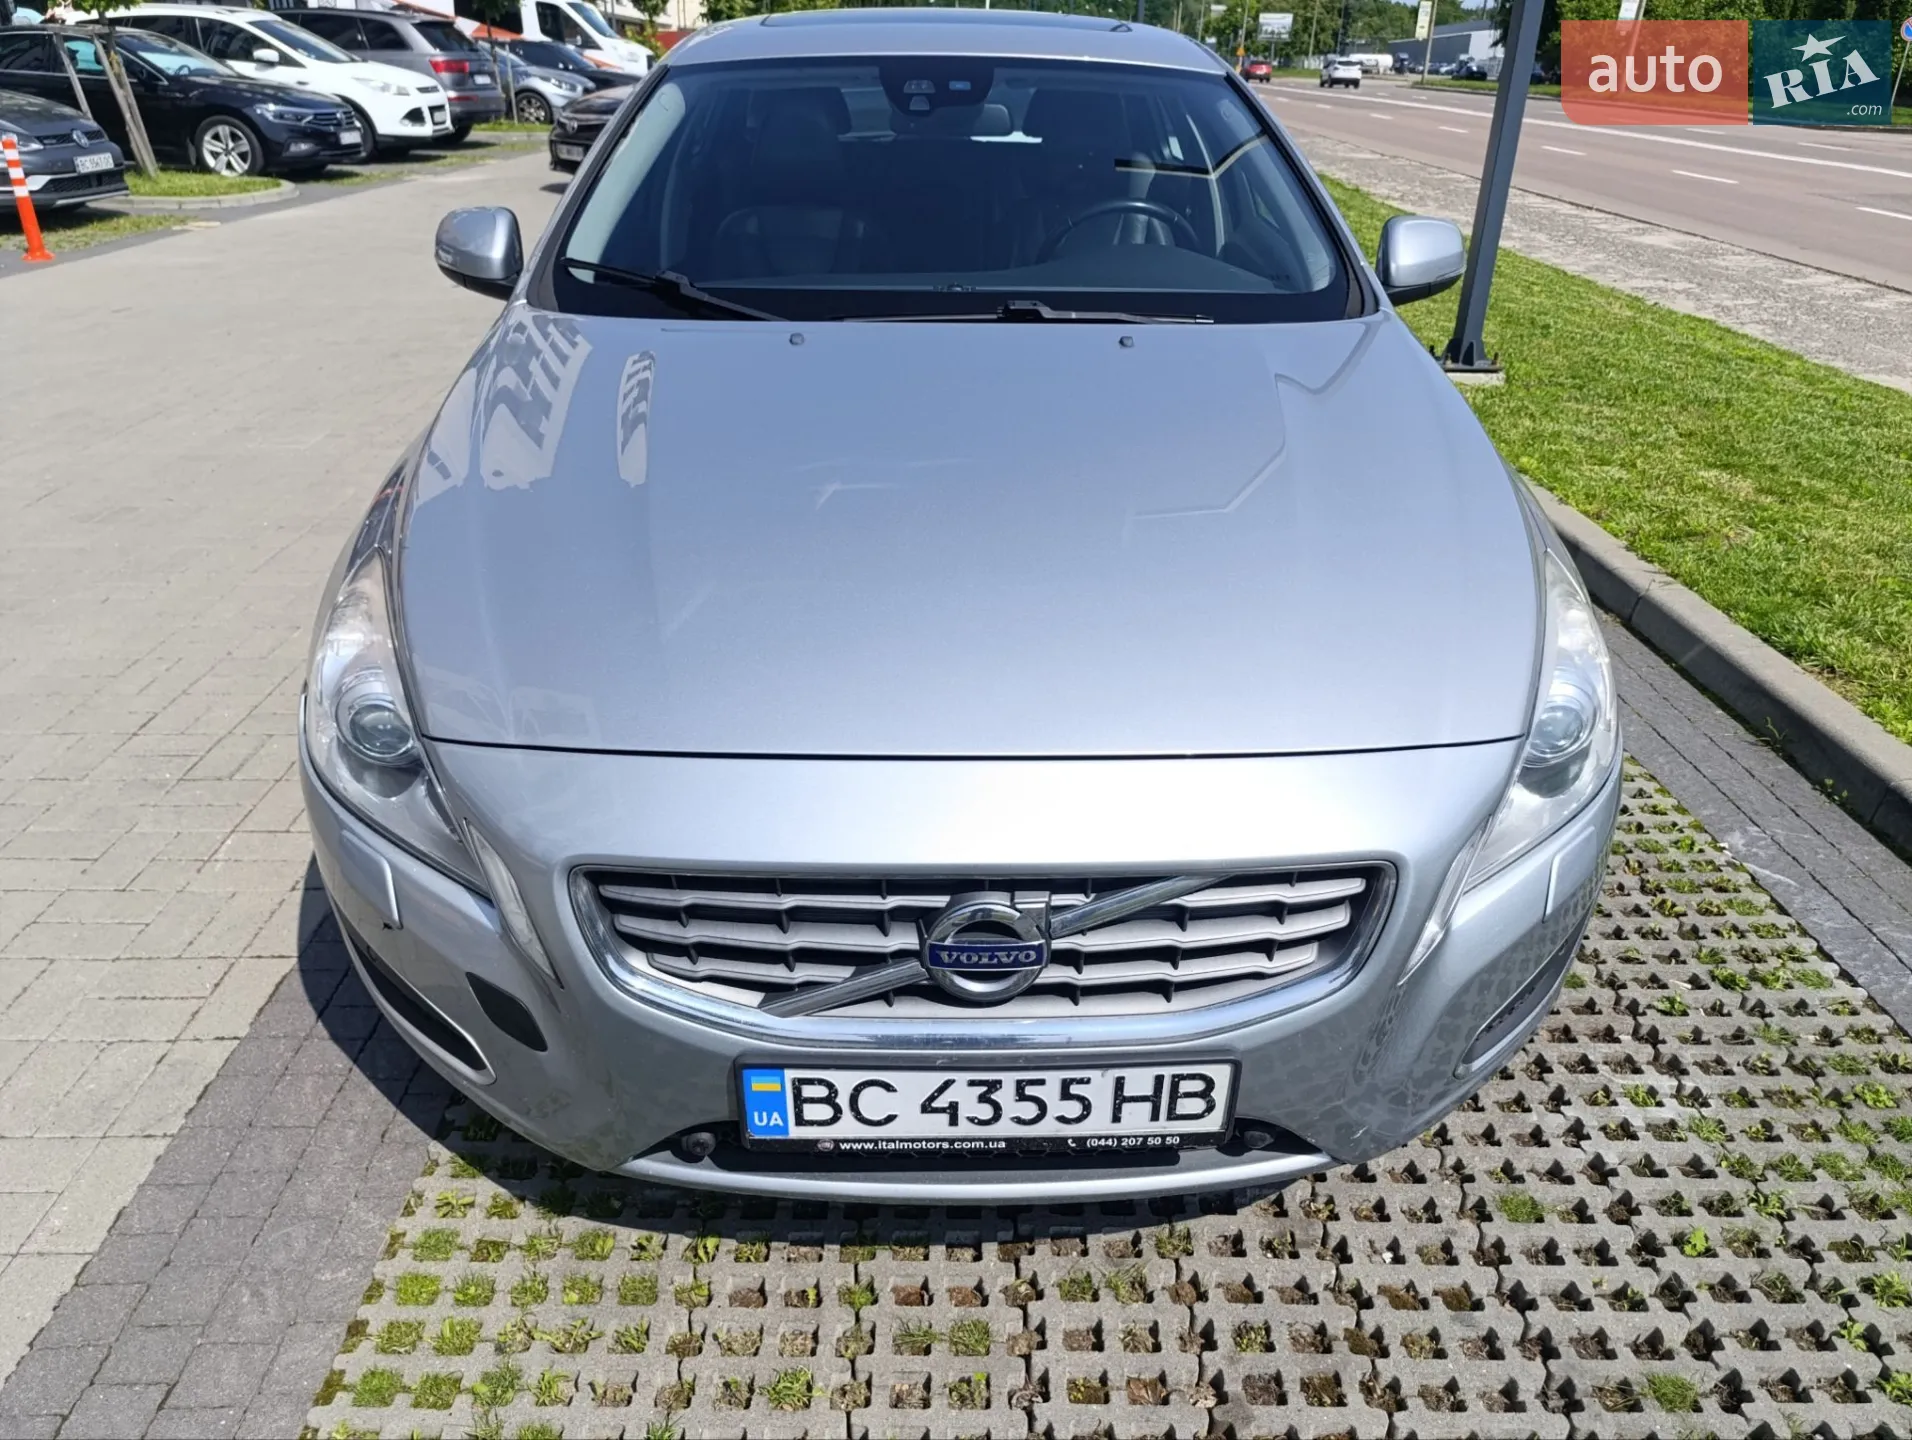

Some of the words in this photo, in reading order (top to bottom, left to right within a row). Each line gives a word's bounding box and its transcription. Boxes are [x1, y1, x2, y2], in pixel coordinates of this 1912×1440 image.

[936, 950, 1037, 964] VOLVO
[791, 1076, 899, 1127] BC
[920, 1076, 1093, 1127] 4355
[1111, 1072, 1217, 1124] HB
[753, 1111, 784, 1127] UA
[839, 1139, 1006, 1150] www.italmotors.com.ua
[1086, 1137, 1118, 1148] (044)
[1121, 1137, 1143, 1146] 207
[1147, 1137, 1162, 1145] 50
[1165, 1136, 1180, 1145] 50
